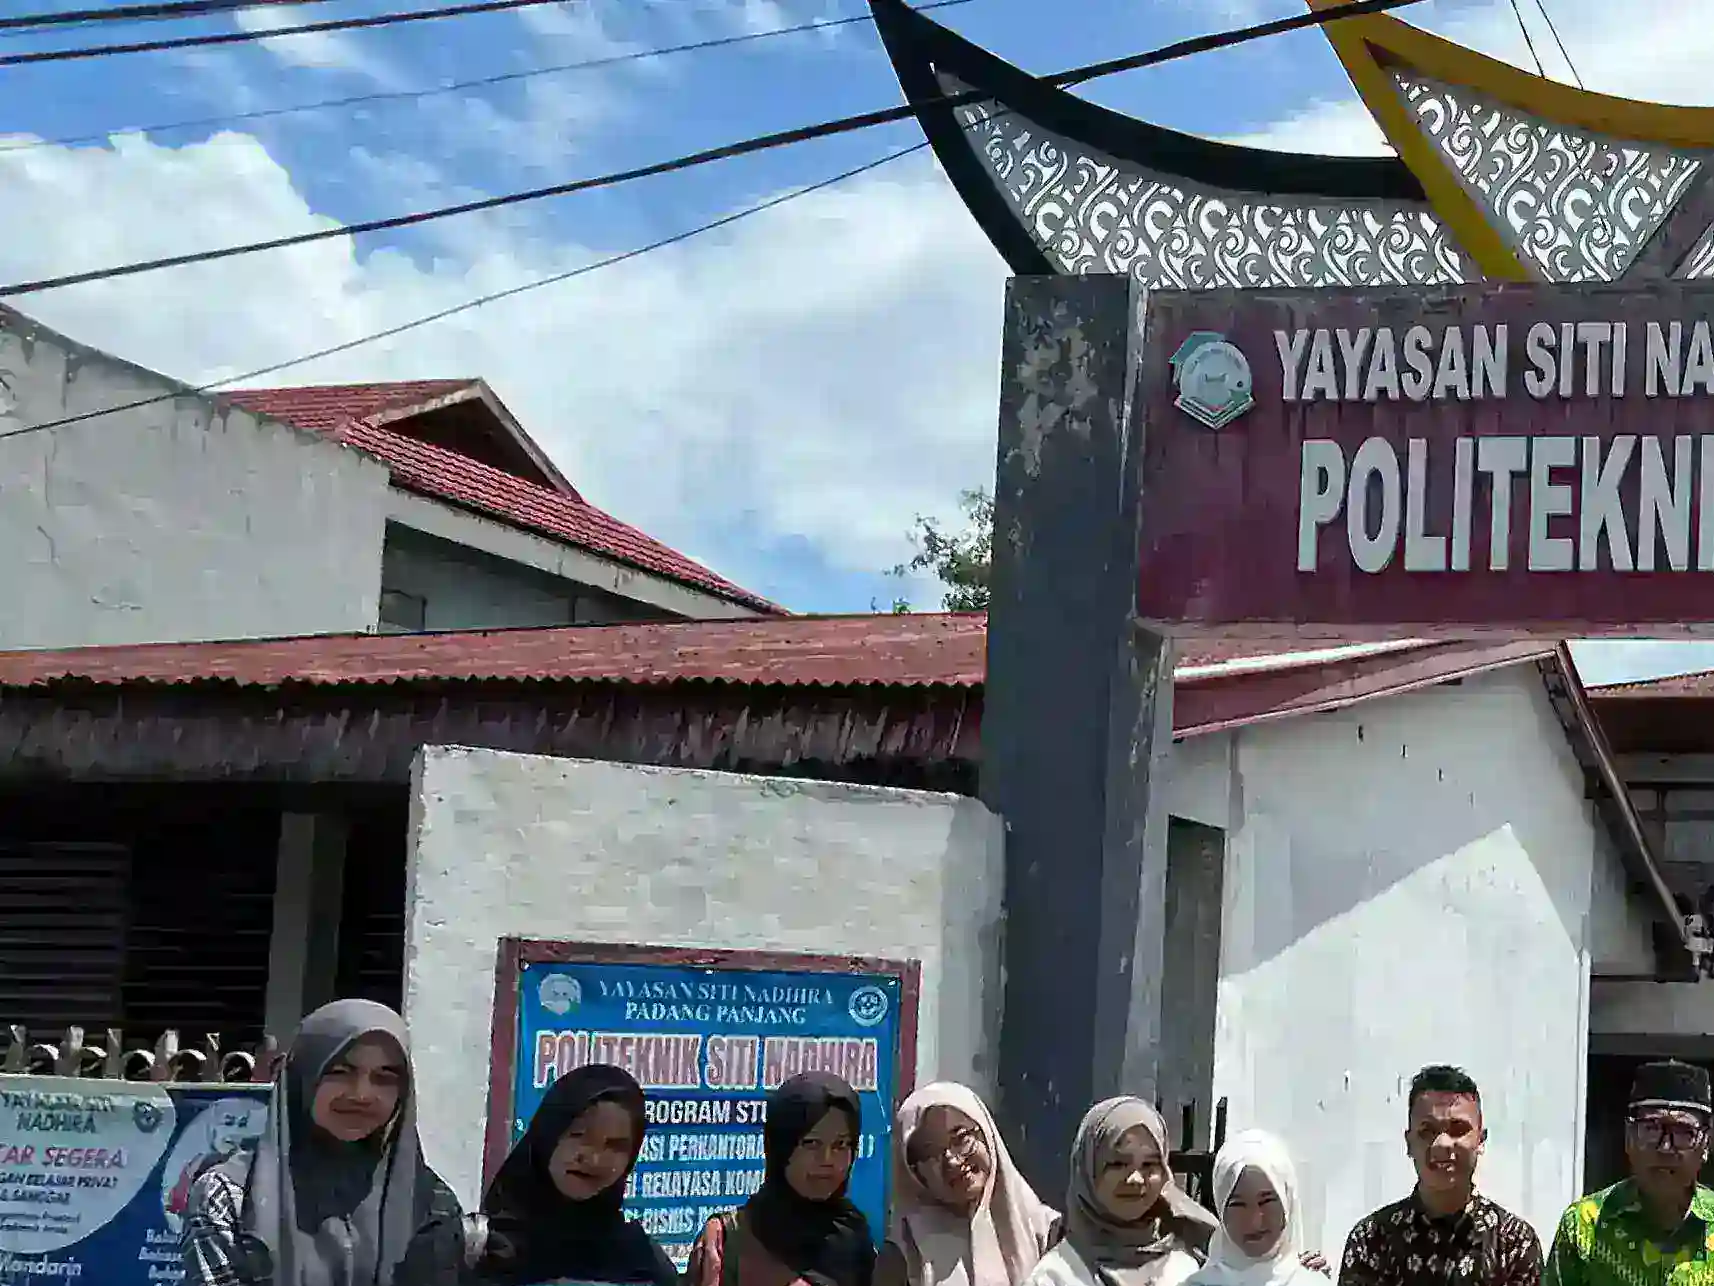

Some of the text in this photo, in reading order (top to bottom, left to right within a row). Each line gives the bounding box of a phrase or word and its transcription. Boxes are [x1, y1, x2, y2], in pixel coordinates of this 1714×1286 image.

[1274, 322, 1508, 400] YAYASAN
[1523, 321, 1627, 399] SITI
[599, 979, 834, 1005] YAYASAN SITI NADHIRA
[625, 1000, 807, 1025] PADANG PANJANG
[704, 1033, 760, 1090] SITI
[762, 1036, 878, 1091] NADHIRA
[644, 1100, 730, 1124] ROGRAM
[669, 1133, 766, 1162] PERKANTORA
[642, 1169, 721, 1198] REKAYASA
[642, 1206, 695, 1235] BISNIS
